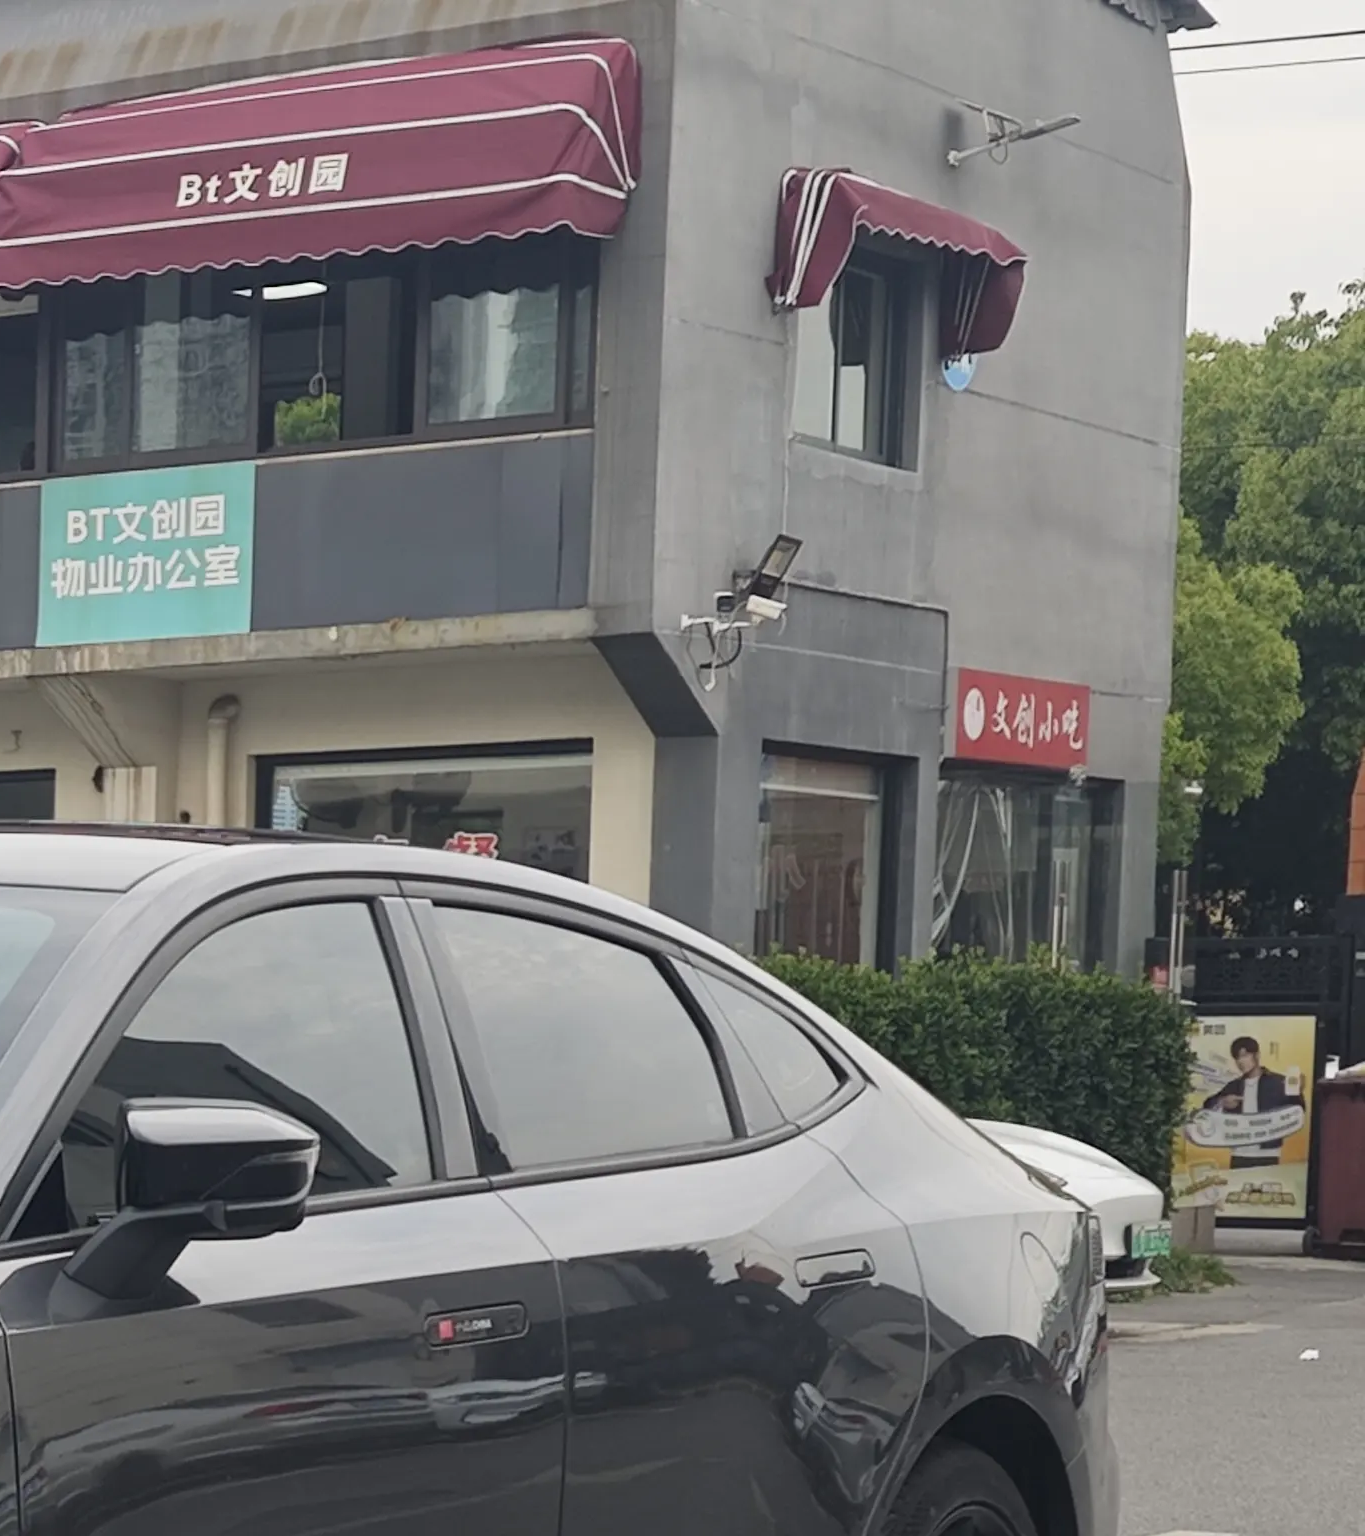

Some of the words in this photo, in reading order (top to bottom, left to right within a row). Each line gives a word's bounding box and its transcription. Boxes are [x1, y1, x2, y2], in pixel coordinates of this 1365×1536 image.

[176, 152, 349, 208] Bt文创园
[66, 493, 226, 545] BT文创园
[50, 543, 242, 600] 物业办公室
